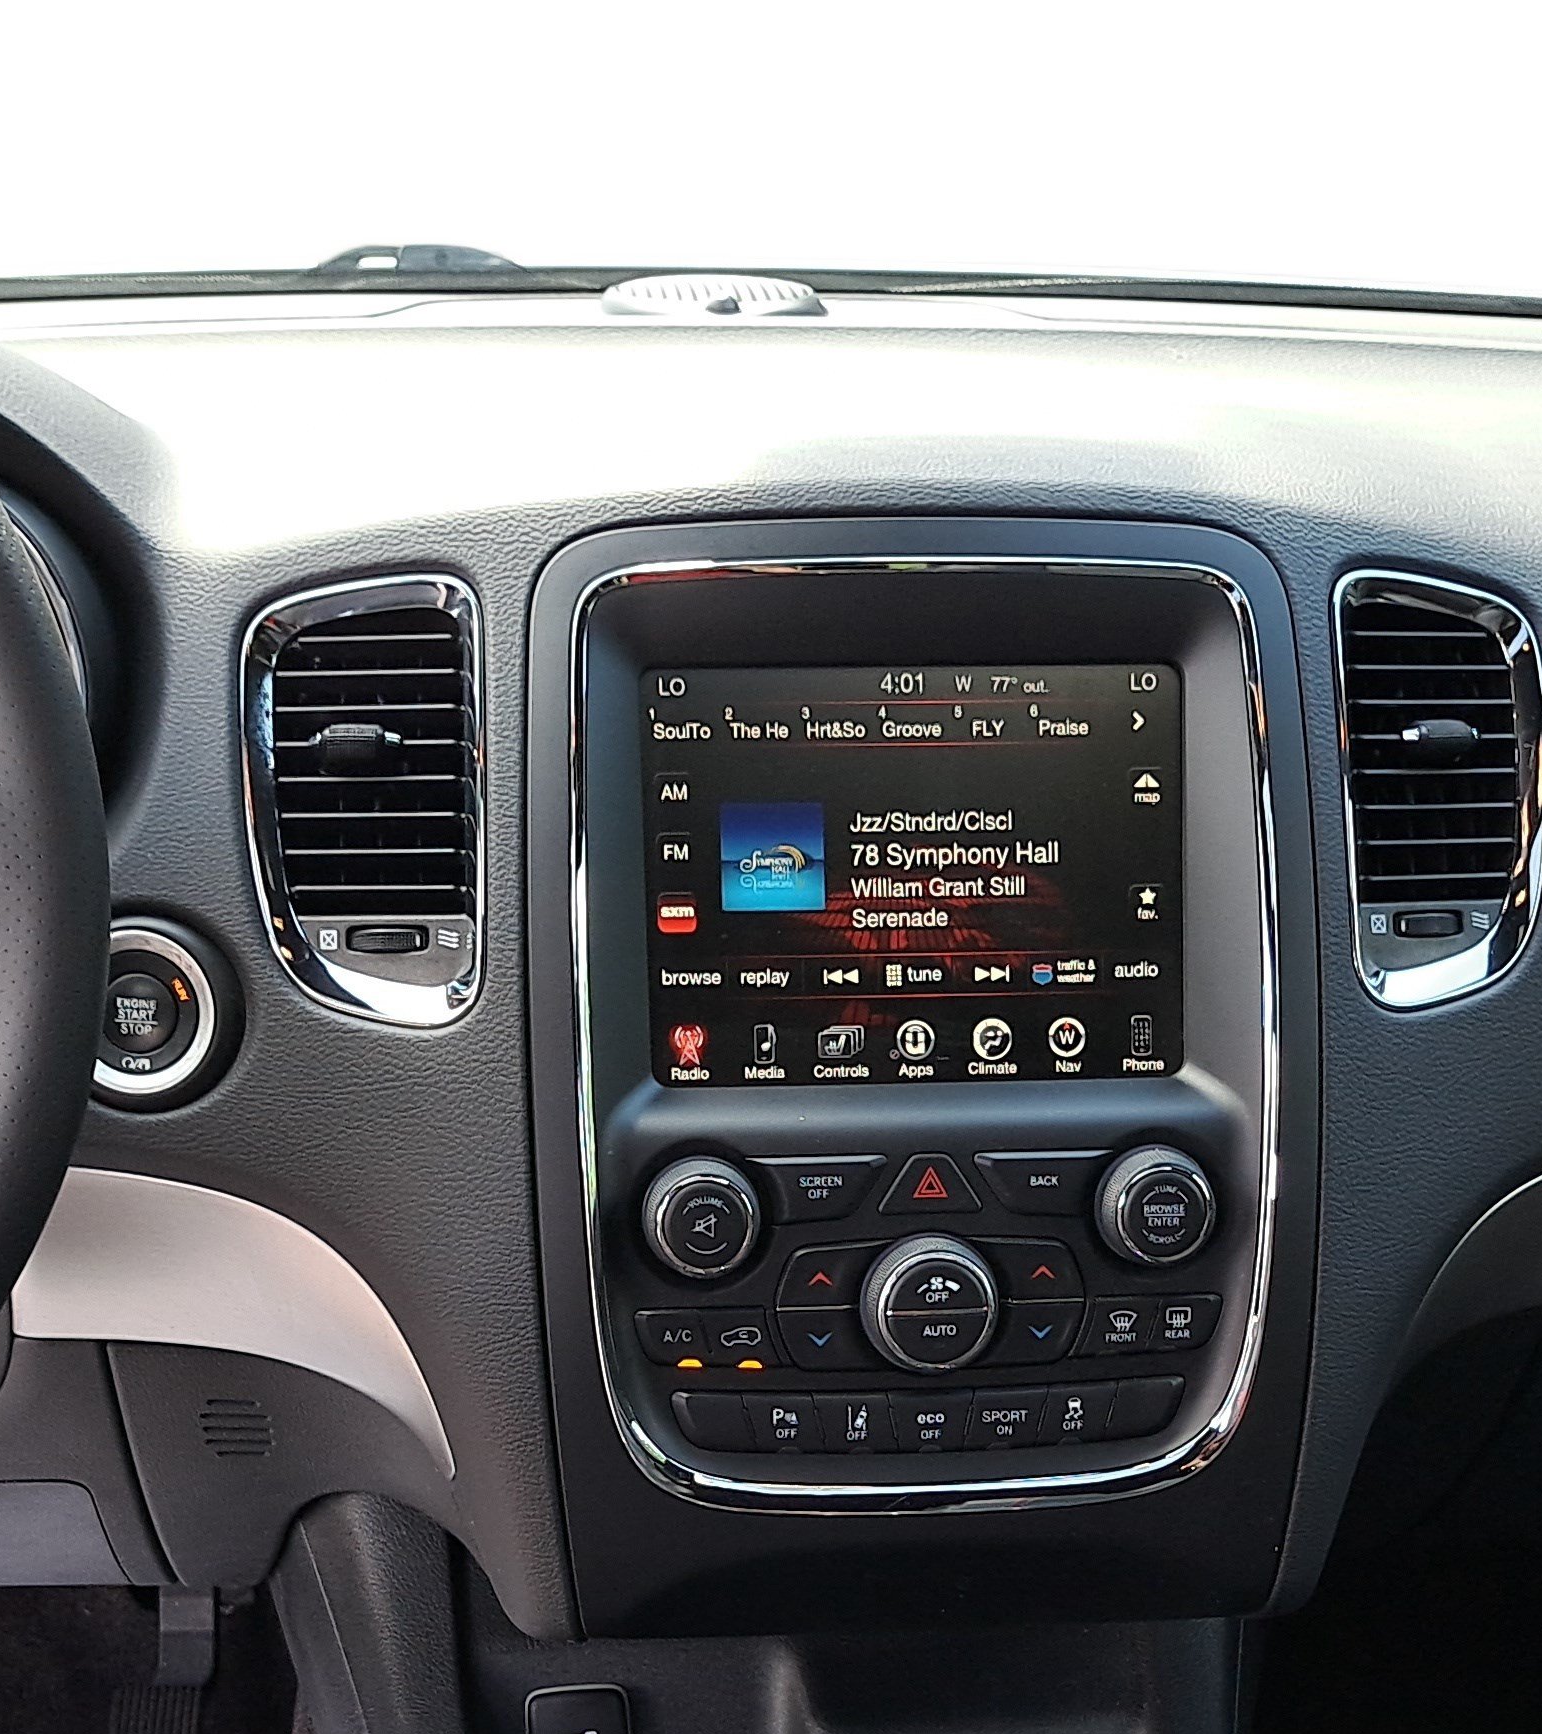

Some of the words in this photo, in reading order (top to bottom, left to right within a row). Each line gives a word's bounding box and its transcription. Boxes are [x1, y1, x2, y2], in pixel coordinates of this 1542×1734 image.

[658, 677, 687, 696] LO
[880, 672, 923, 695] 4:01
[954, 674, 972, 693] W
[990, 676, 1018, 693] 77°
[1023, 681, 1050, 693] out.
[1130, 672, 1157, 692] LO
[648, 707, 655, 721] 1
[724, 706, 734, 720] 2
[801, 706, 810, 720] 3
[878, 705, 887, 720] 4
[729, 721, 760, 740] The
[766, 721, 789, 739] He
[806, 720, 866, 740] Hrt&So
[882, 720, 942, 739] Groove
[972, 719, 1004, 738] FLY
[1039, 718, 1089, 737] Praise
[661, 783, 688, 800] AM
[1134, 792, 1160, 804] map
[663, 843, 689, 861] FM
[851, 843, 879, 866] 78
[886, 841, 1009, 870] Symphony
[1016, 840, 1059, 863] Hall
[851, 876, 923, 898] William
[929, 876, 985, 898] Grant
[989, 875, 1025, 897] Still
[660, 906, 695, 918] sxm
[852, 906, 948, 928] Serenade
[1138, 907, 1159, 920] fav.
[1057, 960, 1086, 971] traffic
[1087, 959, 1096, 970] &
[1115, 961, 1159, 977] audio
[661, 968, 722, 986] browse
[740, 968, 790, 987] replay
[907, 966, 942, 981] tune
[1057, 972, 1095, 983] weather
[116, 996, 157, 1010] ENGINE
[117, 1009, 156, 1021] START
[119, 1023, 153, 1035] STOP
[813, 1064, 869, 1078] Controls
[899, 1063, 934, 1077] Apps
[968, 1061, 1017, 1075] Climate
[1056, 1060, 1081, 1073] Nav
[1122, 1059, 1164, 1071] Phone
[671, 1067, 710, 1080] Radio
[744, 1066, 785, 1079] Media
[799, 1176, 843, 1188] SCREEN
[1029, 1175, 1059, 1187] BACK
[807, 1188, 830, 1199] OFF
[1154, 1185, 1179, 1195] TUNE
[687, 1195, 725, 1209] VOLUME
[1143, 1203, 1186, 1214] BROWSE
[1147, 1217, 1180, 1227] ENTER
[925, 1291, 949, 1304] OFF
[663, 1329, 693, 1343] A/C
[922, 1324, 957, 1337] AUTO
[1105, 1332, 1137, 1343] FRONT
[1165, 1329, 1191, 1339] REAR
[917, 1413, 945, 1424] eco
[981, 1409, 1028, 1422] SPORT
[996, 1425, 1013, 1436] ON
[1062, 1420, 1084, 1431] OFF
[775, 1428, 798, 1439] OFF
[846, 1430, 868, 1441] OFF
[920, 1429, 941, 1440] OFF
